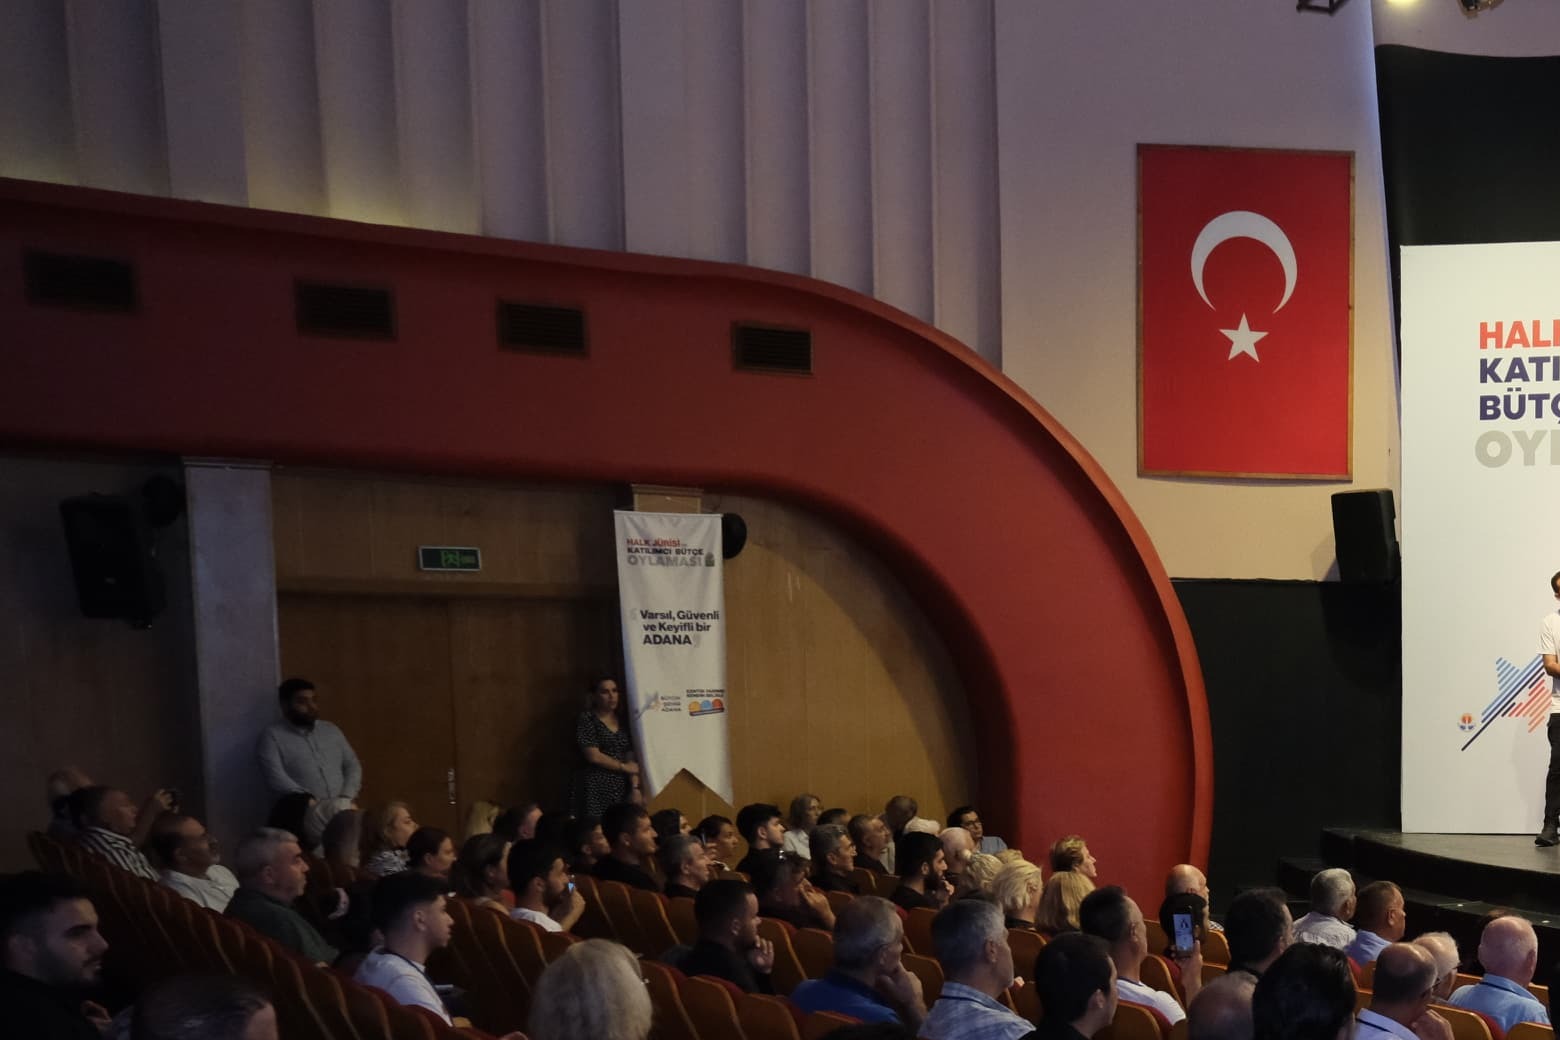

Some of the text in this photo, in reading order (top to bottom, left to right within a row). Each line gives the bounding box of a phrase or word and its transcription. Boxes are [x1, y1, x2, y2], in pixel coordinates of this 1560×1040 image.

[627, 555, 702, 567] OYLAMASI
[677, 610, 720, 620] Güvenli
[643, 622, 711, 633] ve Keyifli bir
[643, 634, 692, 645] ADANA
